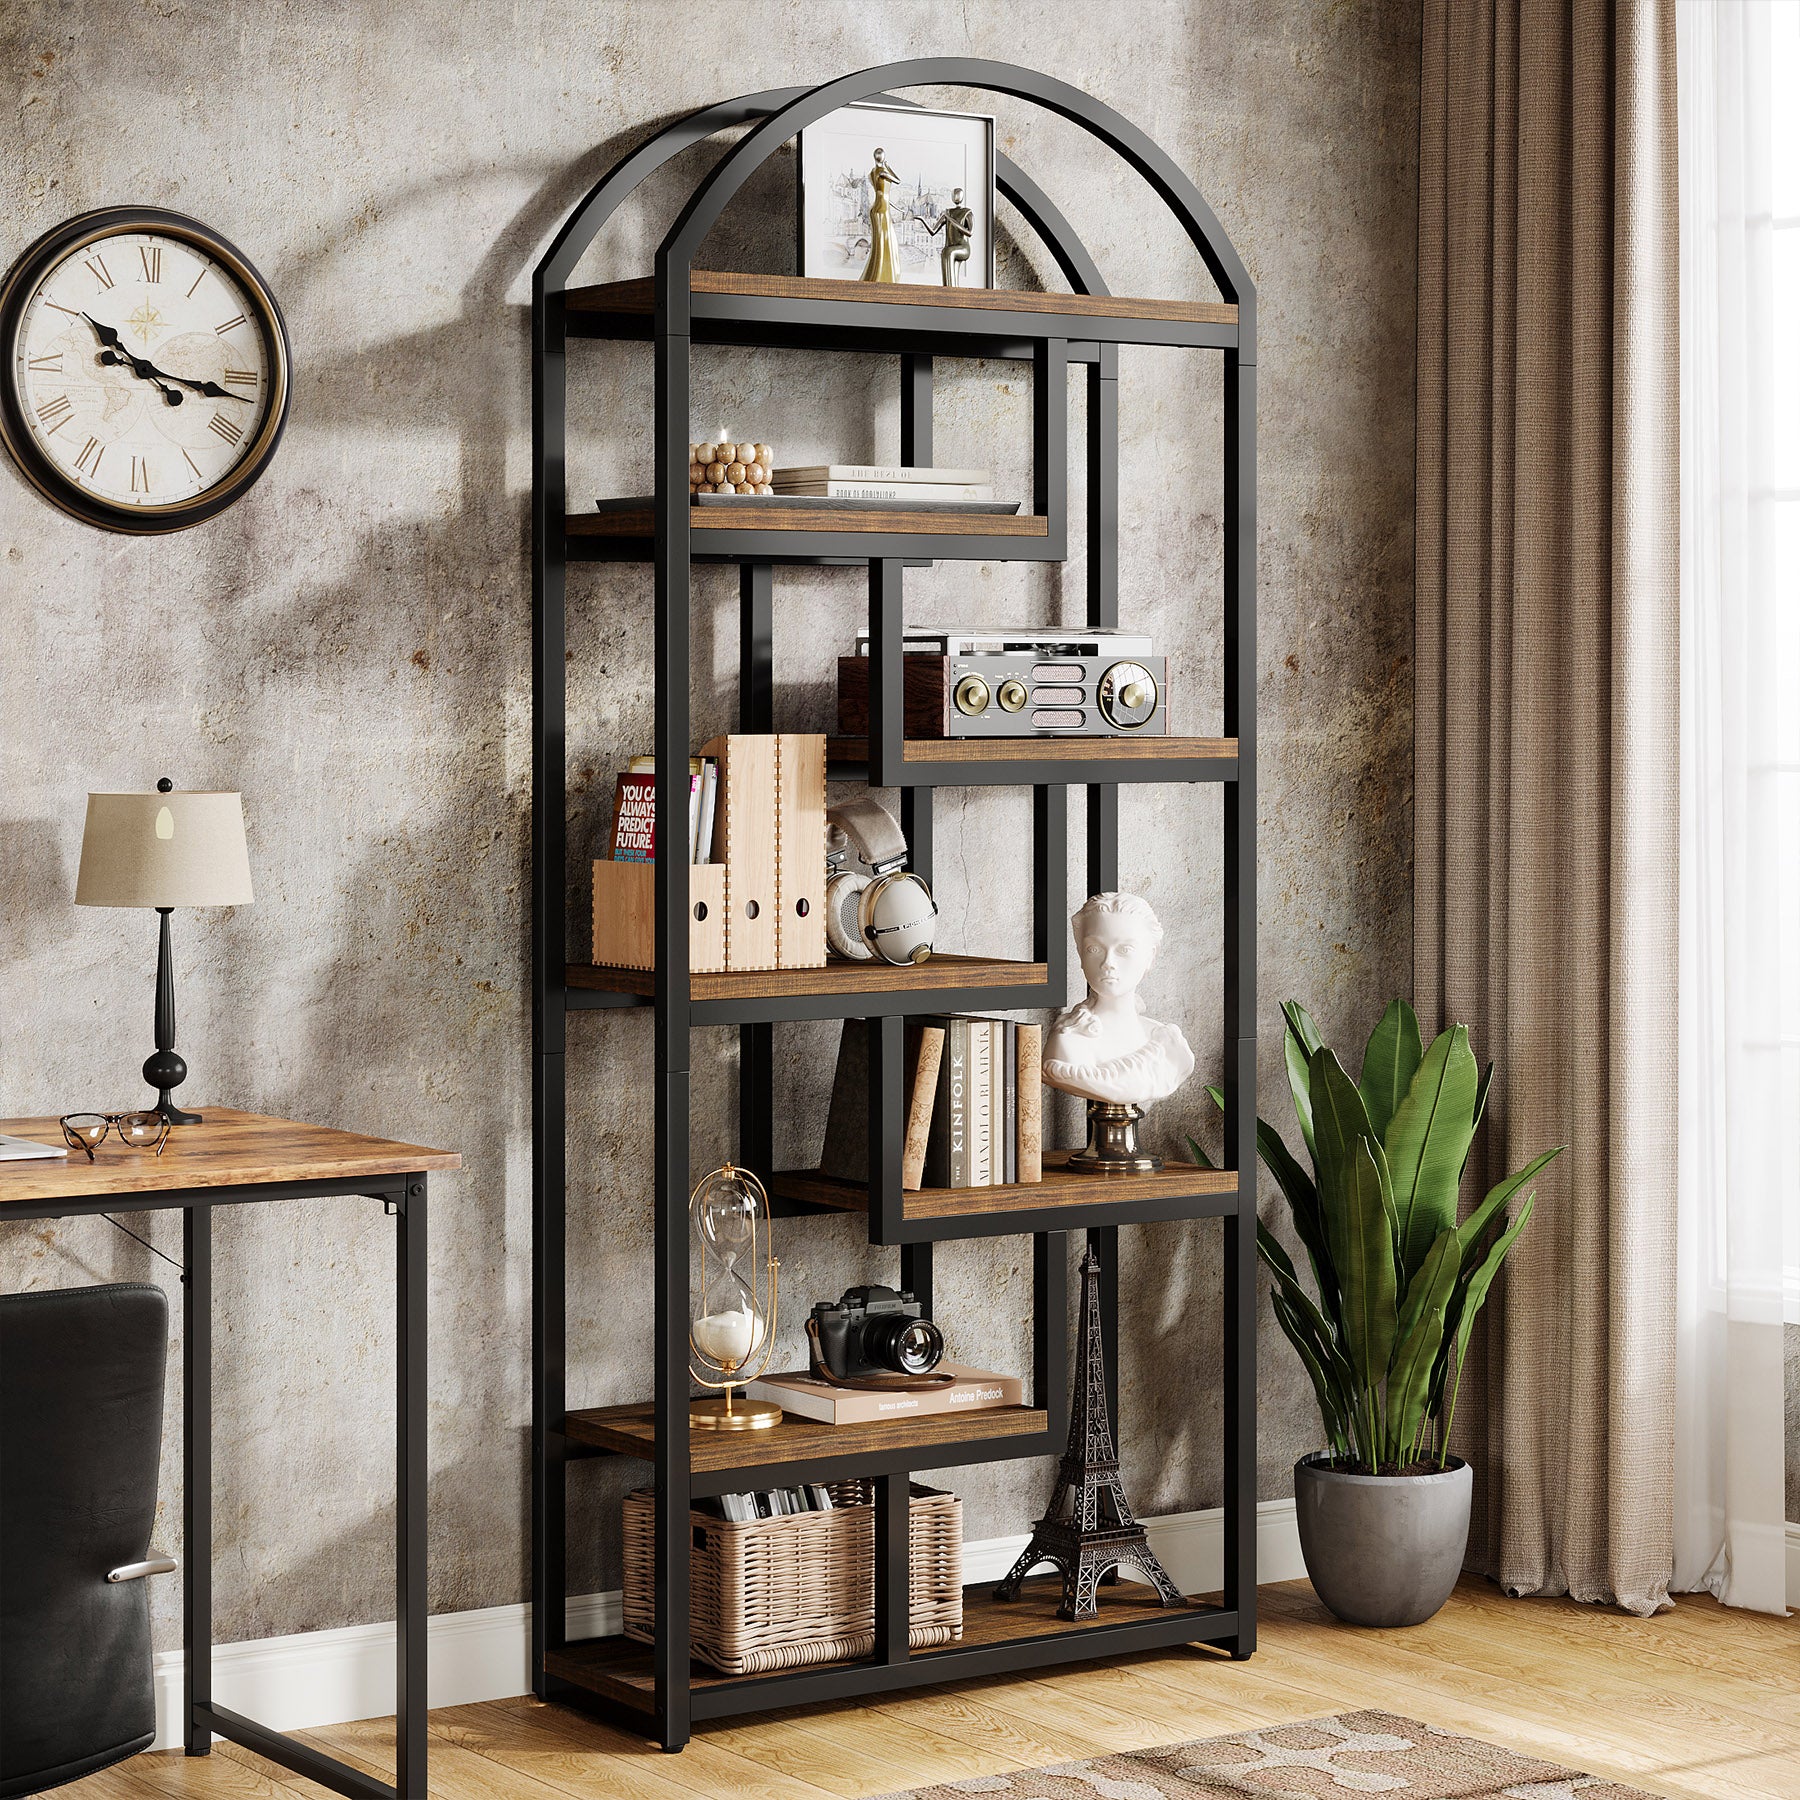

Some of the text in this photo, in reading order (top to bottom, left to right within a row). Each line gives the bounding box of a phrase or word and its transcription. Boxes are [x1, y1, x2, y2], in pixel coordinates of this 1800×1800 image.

[83, 252, 117, 296] XI
[136, 246, 163, 284] XII
[214, 313, 248, 337] II
[28, 351, 64, 376] IX
[224, 366, 258, 388] III
[622, 785, 655, 802] YOU CA
[617, 816, 655, 834] PREDICT
[615, 832, 653, 849] FUTURE.
[953, 1055, 963, 1153] KINFOLK
[878, 1400, 919, 1411] famous architects
[949, 1387, 1003, 1404] Antoine Predock
